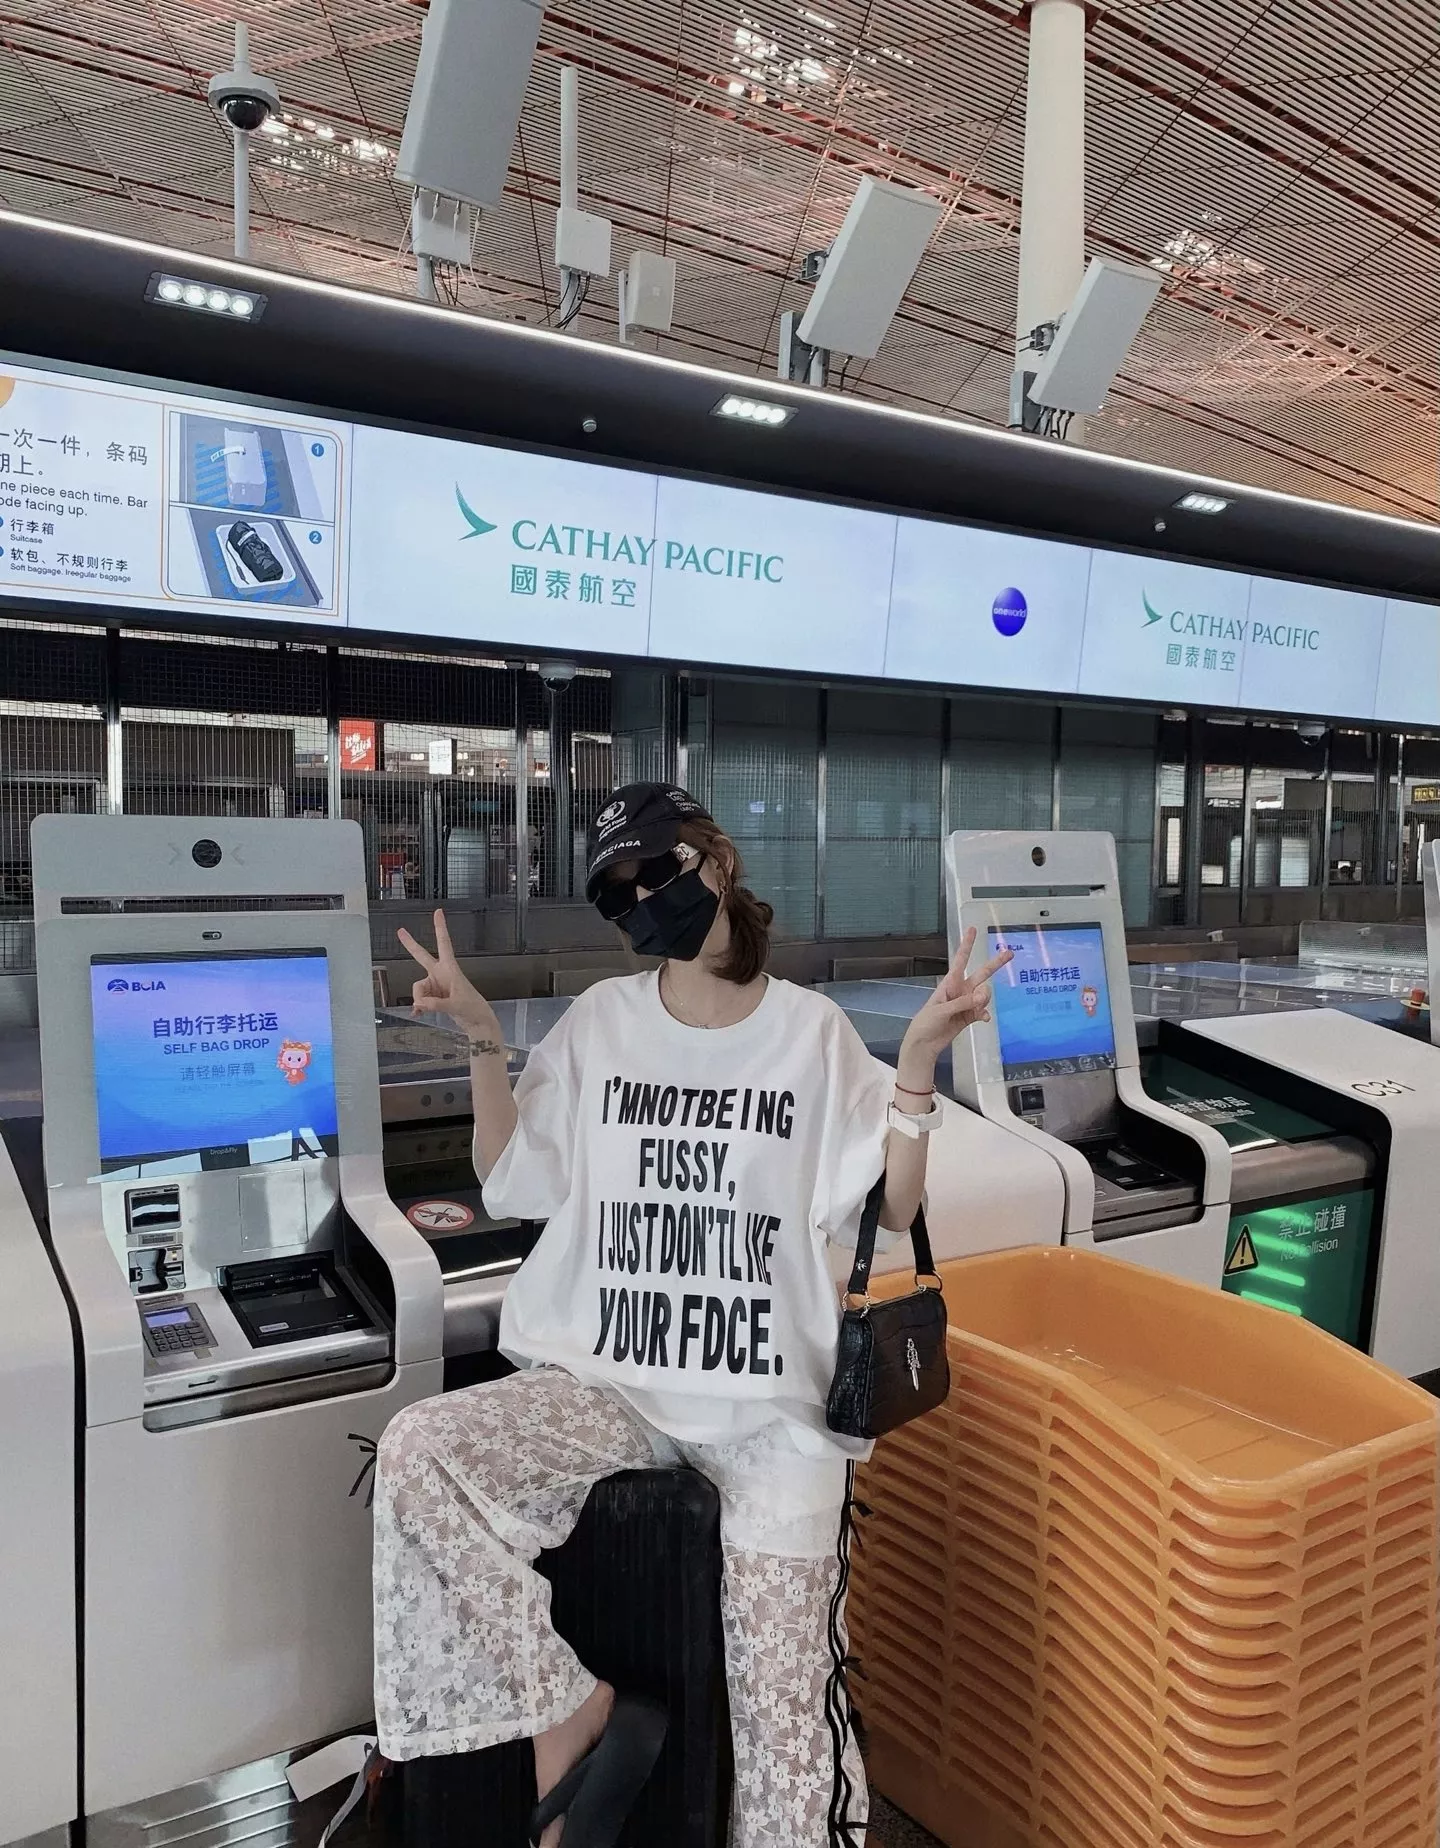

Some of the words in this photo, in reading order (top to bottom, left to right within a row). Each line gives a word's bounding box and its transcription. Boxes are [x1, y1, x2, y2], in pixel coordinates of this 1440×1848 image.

[0, 481, 16, 491] ne
[21, 483, 55, 496] piece
[60, 489, 89, 500] each
[94, 492, 123, 506] time.
[127, 496, 148, 508] Bar
[26, 498, 64, 516] facing
[68, 506, 88, 518] up.
[10, 518, 55, 536] 行李箱
[10, 534, 43, 544] Suitcase
[511, 519, 657, 567] CATHAY
[664, 540, 784, 583] PACIFIC
[510, 564, 637, 608] 國泰航空
[1170, 611, 1248, 641] CATHAY
[1252, 622, 1320, 650] PACIFIC
[1166, 643, 1236, 672] 國泰航空
[1019, 966, 1081, 984] 自助行李托运
[1025, 987, 1042, 995] SELF
[1044, 985, 1058, 994] BAG
[1059, 984, 1078, 993] DROP
[153, 1012, 279, 1038] 自助行李托运
[163, 1043, 197, 1055] SELF
[201, 1041, 229, 1053] BAG
[233, 1038, 269, 1051] DROP
[1351, 1080, 1416, 1096] C31
[639, 1138, 735, 1202] FUSSY,
[1278, 1204, 1347, 1241] 禁止碰撞
[592, 1287, 672, 1368] YOUR
